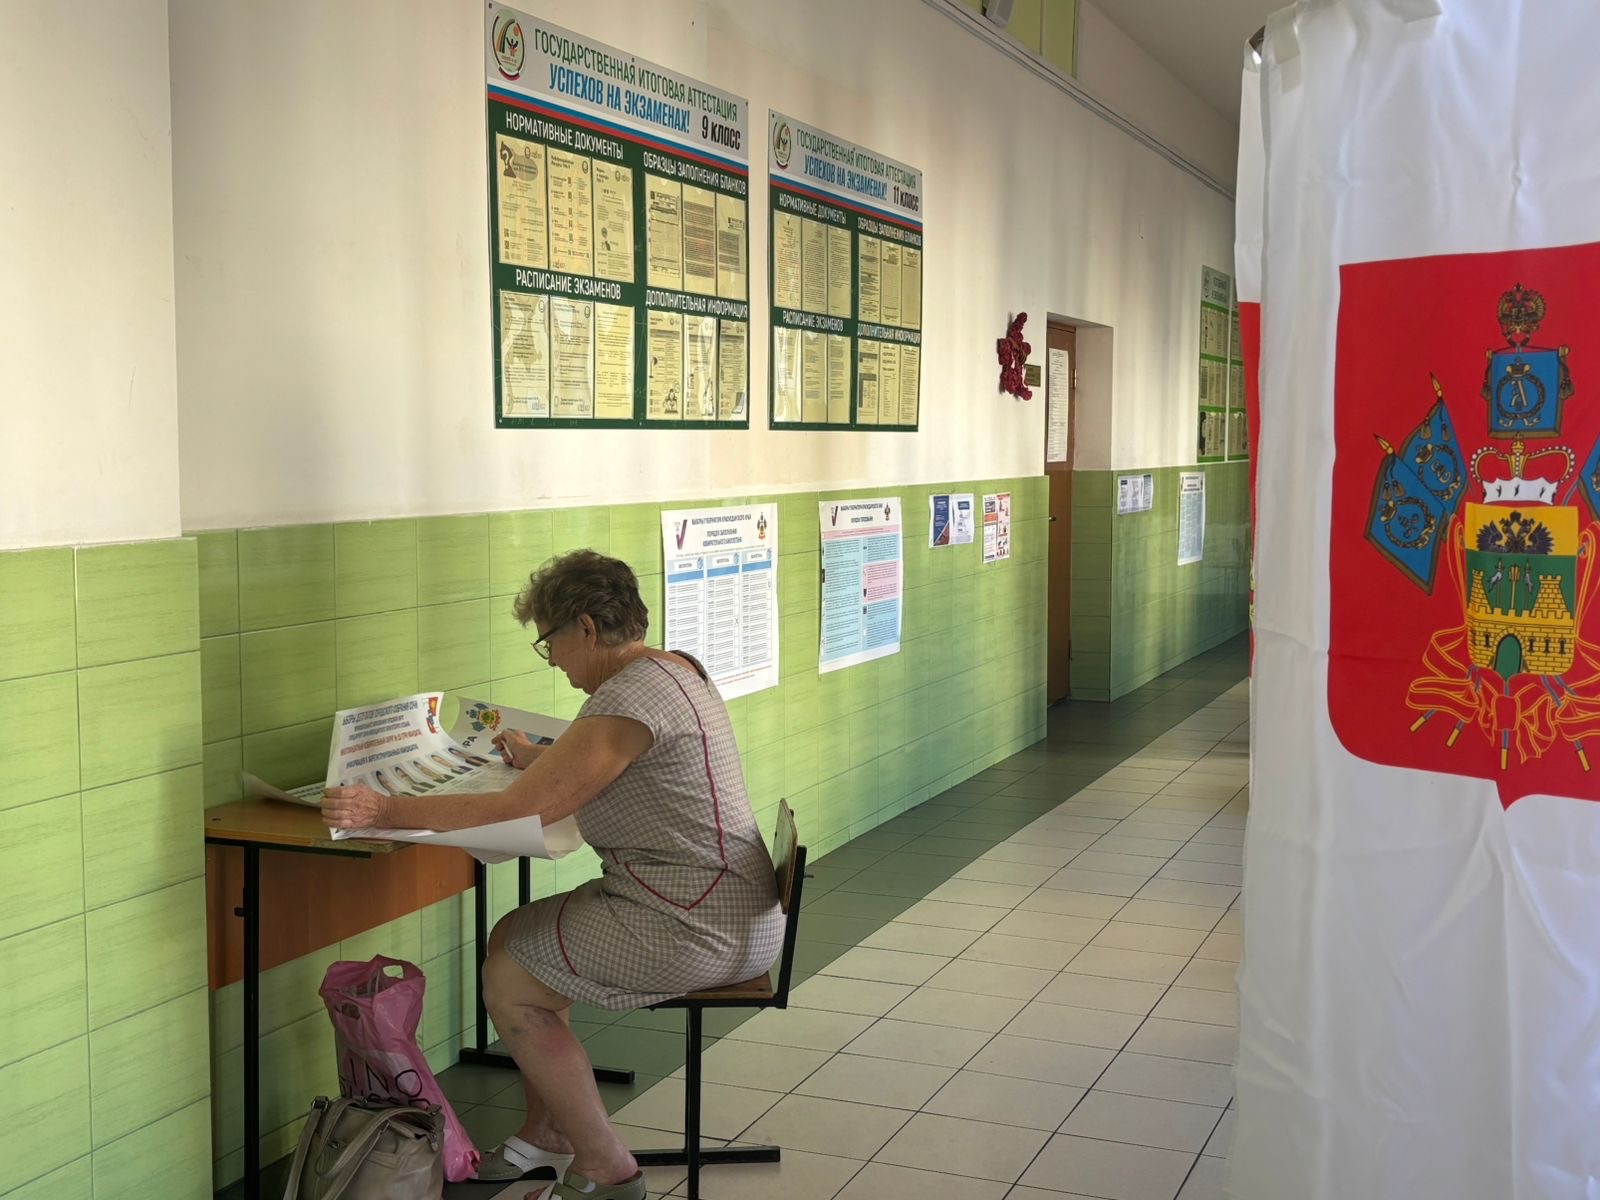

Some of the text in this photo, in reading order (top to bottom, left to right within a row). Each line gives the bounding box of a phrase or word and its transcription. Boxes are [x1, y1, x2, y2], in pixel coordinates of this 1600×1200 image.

[534, 29, 636, 85] ГОСУДАРСТВЕННАЯ
[638, 68, 685, 103] ИТОГОВАЯ
[688, 87, 737, 122] АТТЕСТАЦИЯ
[549, 64, 690, 133] УСПЕХОВ НА ЭКЗАМЕНАХ!
[506, 111, 623, 160] НОРМАТИВНЫЕ ДОКУМЕНТЫ
[702, 116, 708, 139] 9
[797, 129, 855, 165] ГОСУДАРСТВЕННАЯ
[856, 151, 885, 175] ИТОГОВАЯ
[643, 151, 746, 195] ОБРАЗЦЫ ЗАПОЛНЕНИЯ БЛАНКОВ
[804, 155, 836, 183] УСПЕХОВ
[837, 168, 845, 187] НА
[779, 193, 847, 224] НОРМАТИВНЫЕ ДОКУМЕНТЫ
[893, 186, 900, 204] 11
[516, 269, 621, 300] РАСПИСАНИЕ ЭКЗАМЕНОВ
[645, 290, 748, 318] ДОПОЛНИТЕЛЬНАЯ ИНФОРМАЦИЯ
[783, 310, 843, 332] РАСПИСАНИЕ ЭКЗАМЕНОВ
